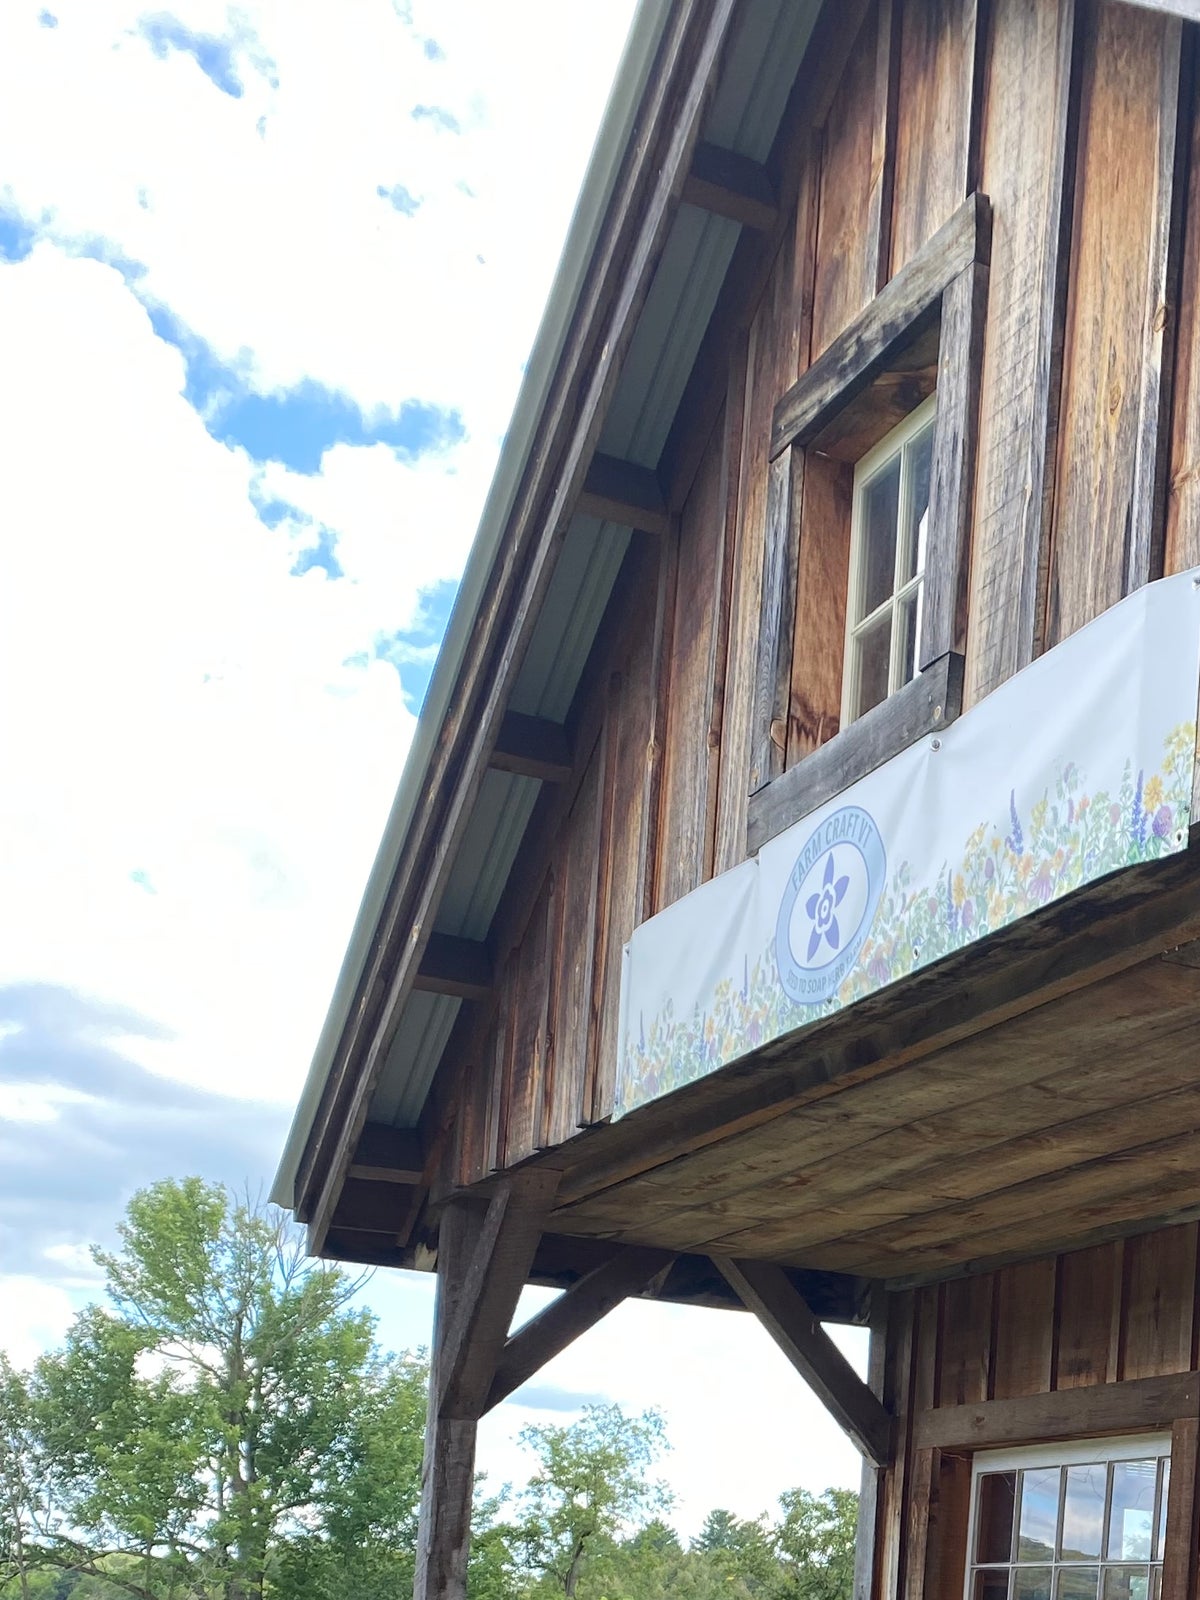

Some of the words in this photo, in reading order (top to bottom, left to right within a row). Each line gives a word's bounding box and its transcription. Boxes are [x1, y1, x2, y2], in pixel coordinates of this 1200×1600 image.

[791, 833, 822, 891] FARM
[825, 813, 860, 845] CRAFT
[858, 819, 874, 849] VT
[798, 978, 806, 994] TO
[807, 976, 827, 994] SOAP
